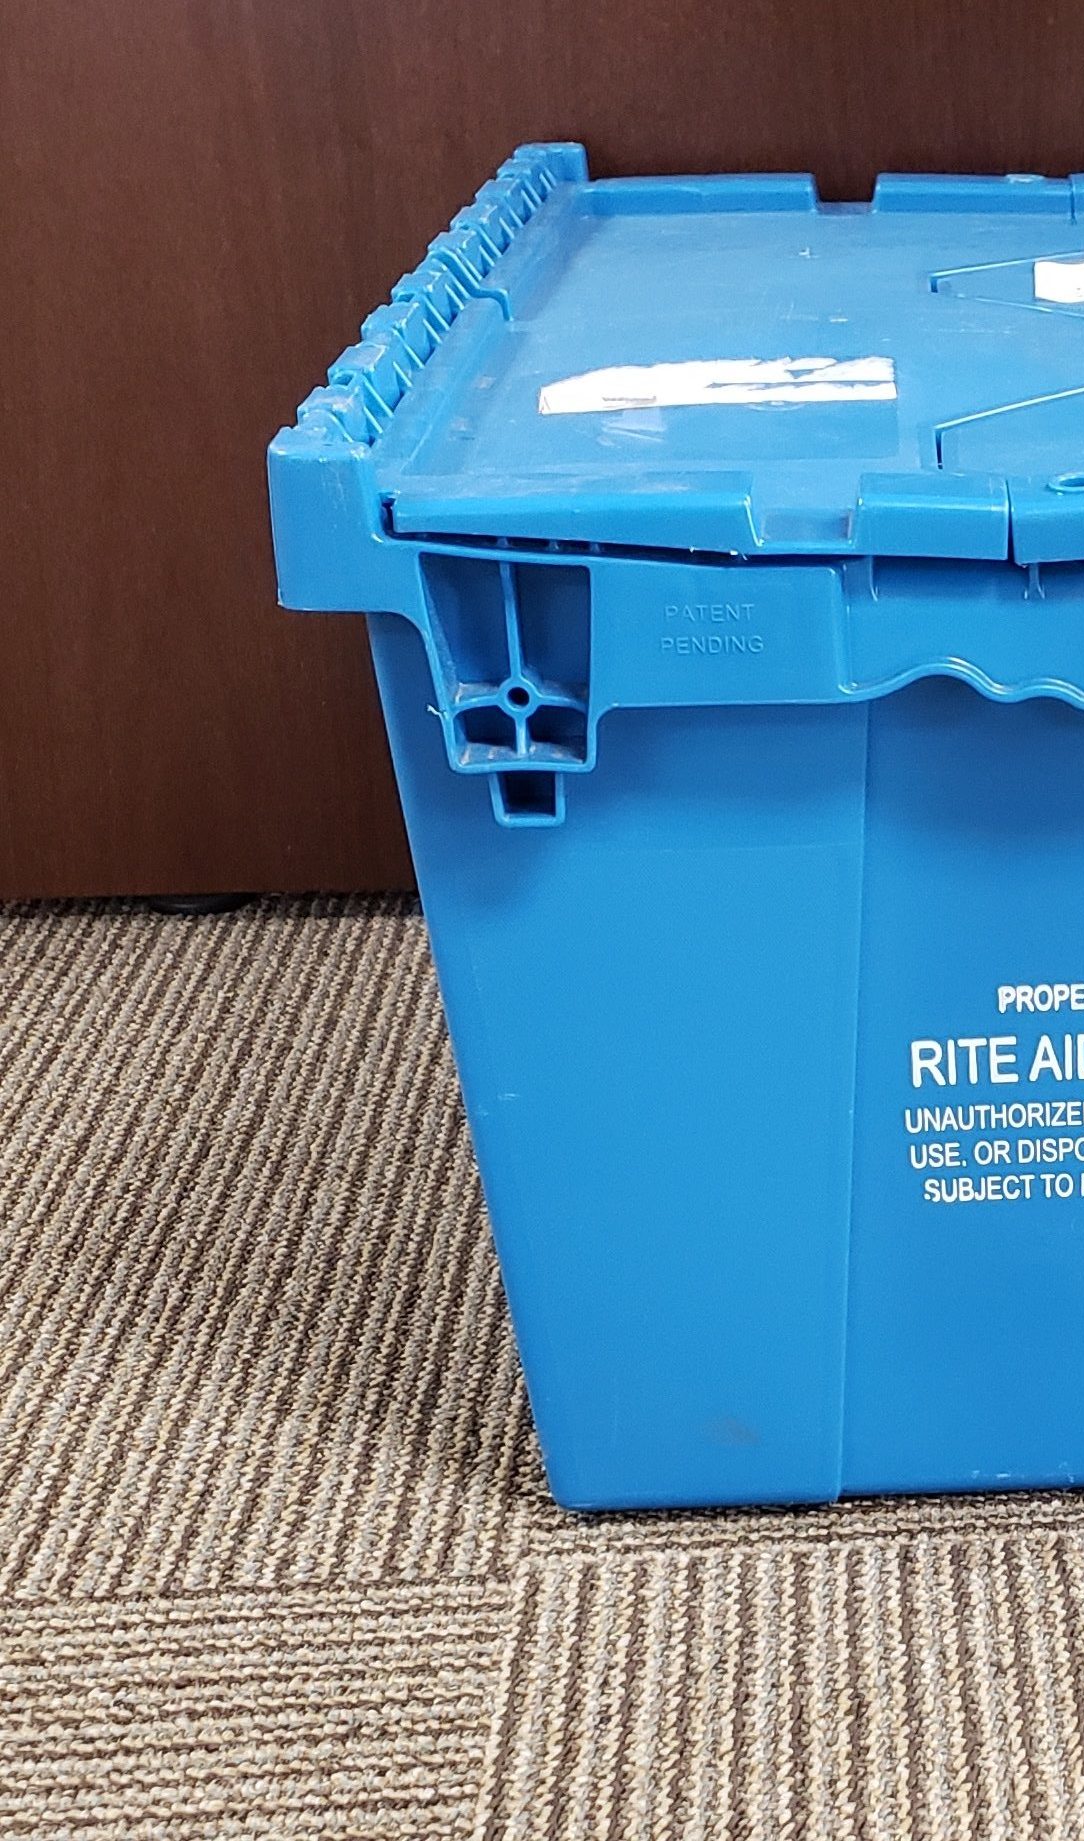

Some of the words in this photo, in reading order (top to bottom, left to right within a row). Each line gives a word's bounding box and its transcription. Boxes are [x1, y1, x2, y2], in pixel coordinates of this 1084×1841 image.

[664, 603, 755, 622] PATENT
[660, 635, 764, 654] PENDING
[910, 1035, 1019, 1088] RITE
[973, 1140, 1012, 1166] OR
[923, 1174, 1036, 1203] SUBJECT
[1039, 1173, 1074, 1198] TO
